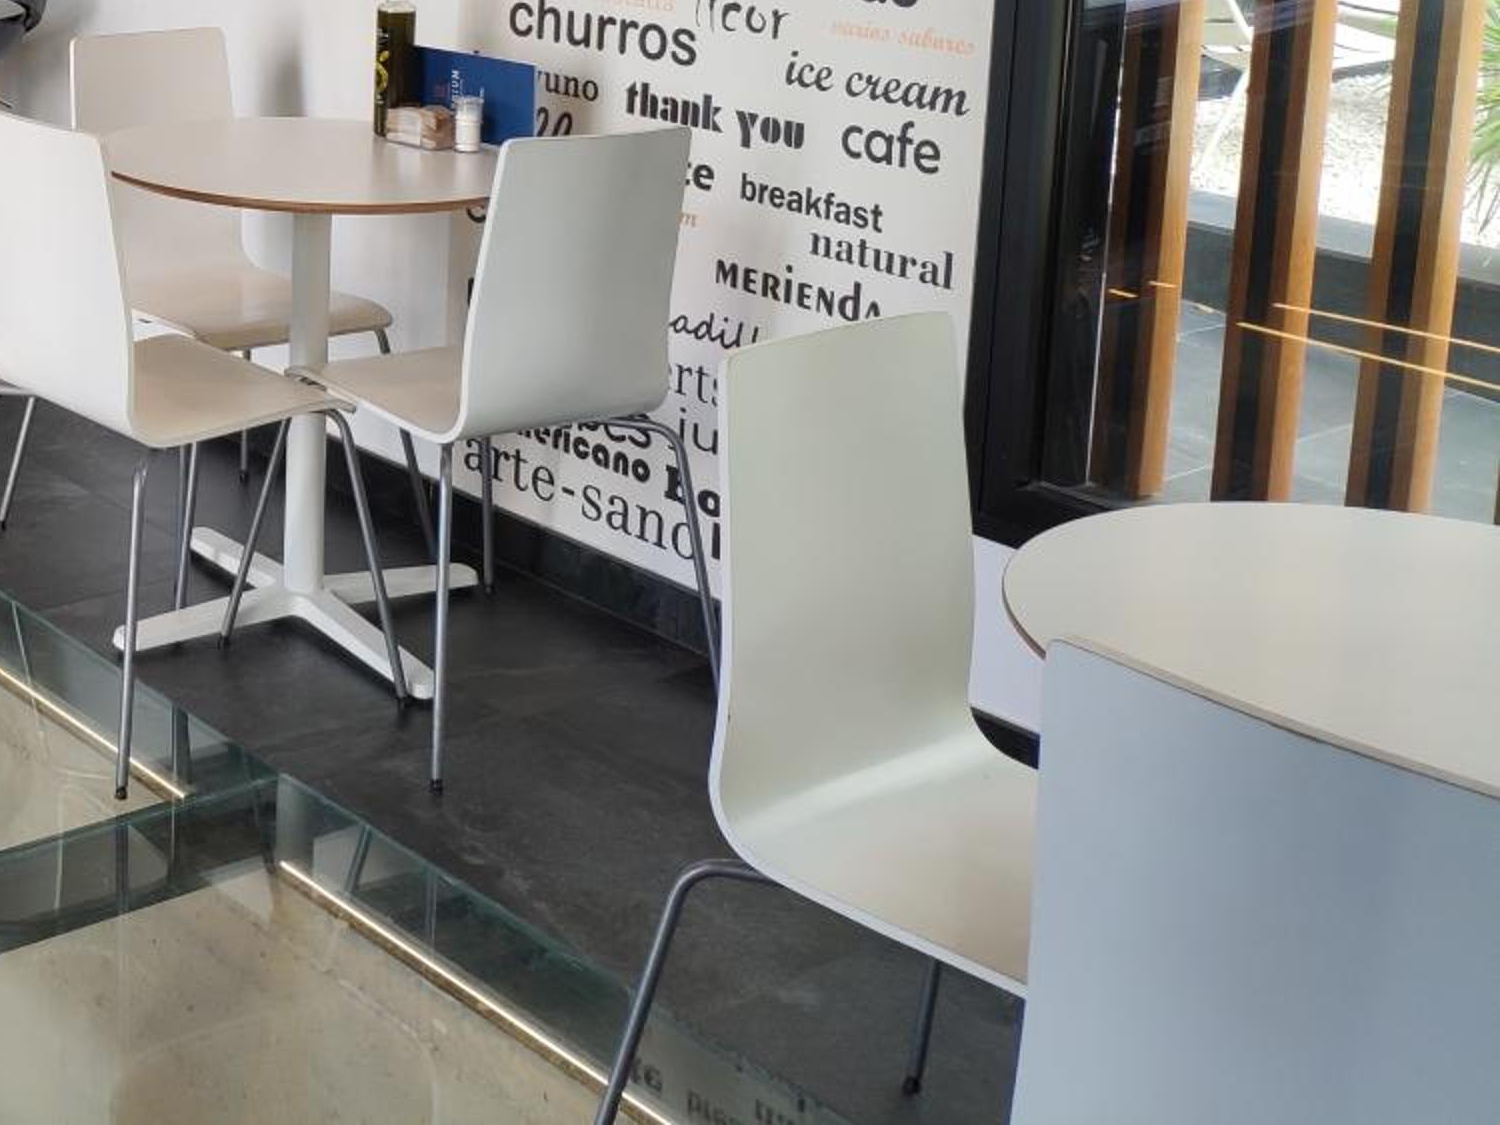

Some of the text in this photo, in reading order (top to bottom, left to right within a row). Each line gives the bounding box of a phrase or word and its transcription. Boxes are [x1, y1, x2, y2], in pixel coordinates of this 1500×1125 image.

[785, 50, 971, 118] ice cream
[624, 80, 723, 133] thank
[736, 109, 806, 150] you
[842, 121, 942, 175] cafe
[740, 173, 883, 233] breakfast
[810, 231, 954, 290] natural
